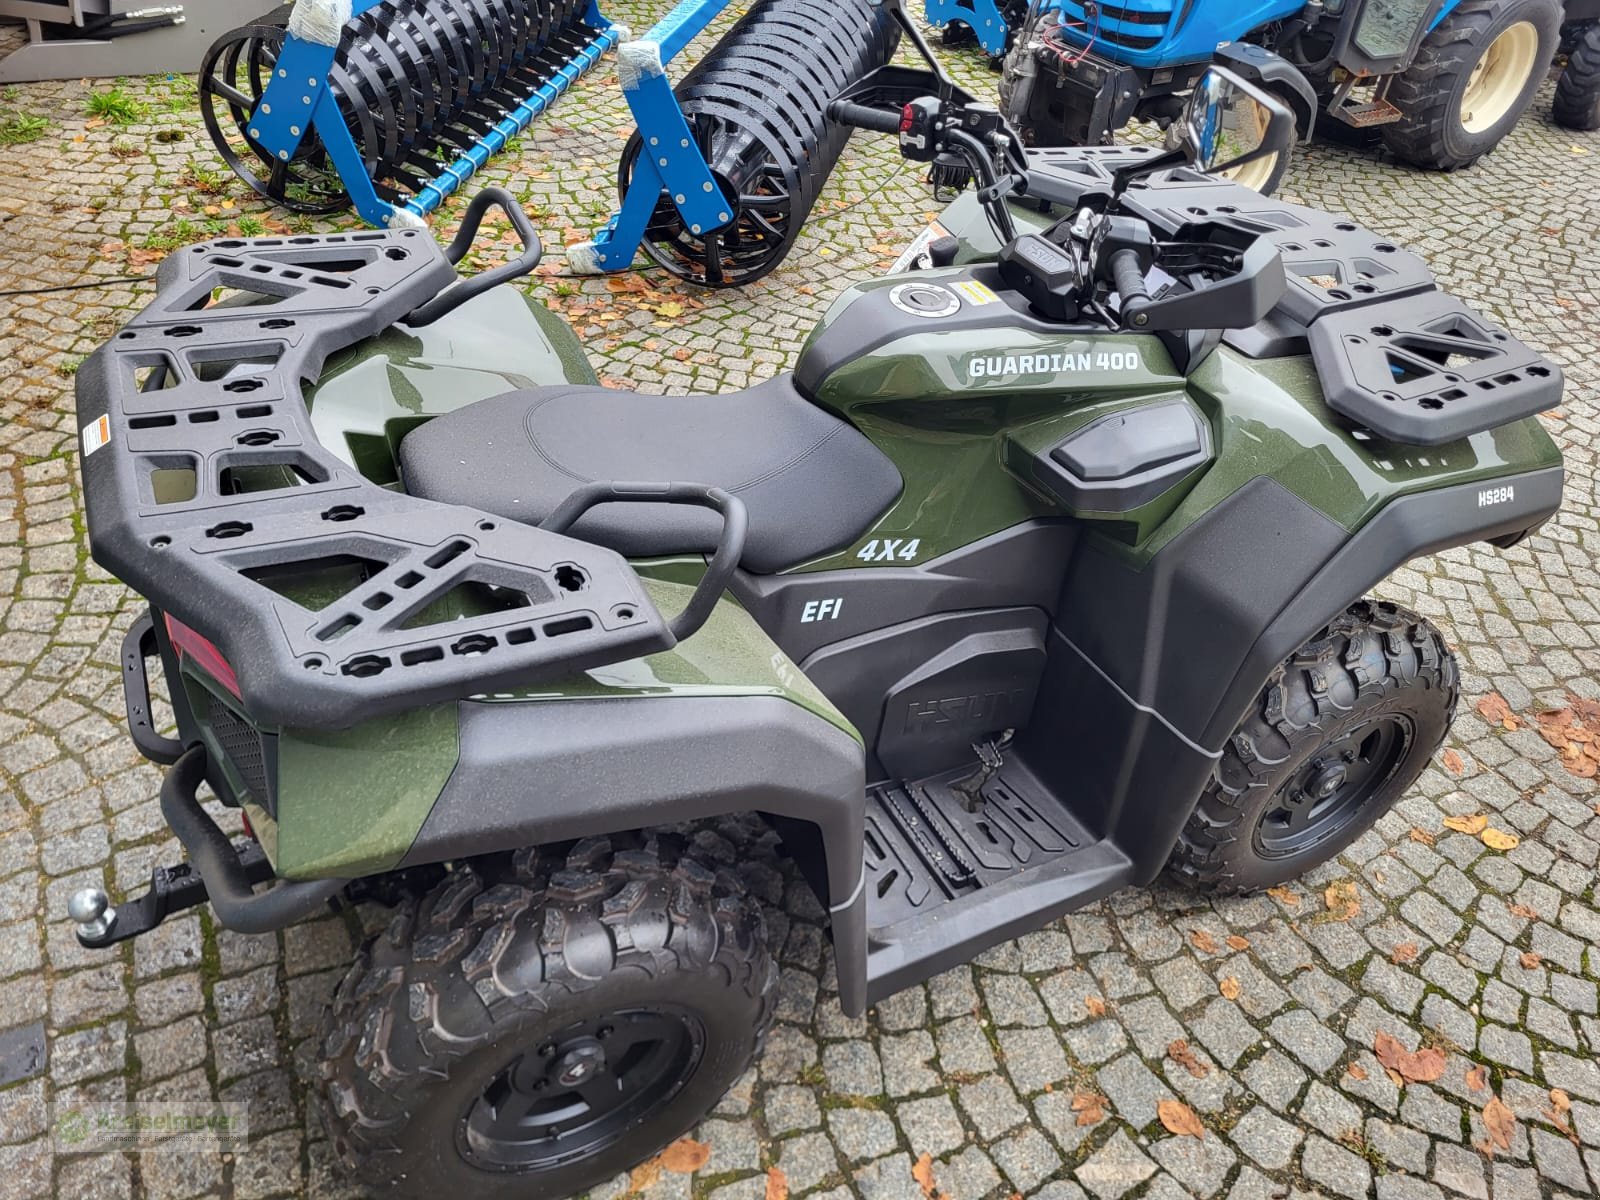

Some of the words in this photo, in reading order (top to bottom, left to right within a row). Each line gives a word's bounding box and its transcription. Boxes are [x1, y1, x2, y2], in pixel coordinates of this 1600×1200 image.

[969, 352, 1092, 377] GUARDIAN
[1096, 352, 1139, 371] 400
[1478, 485, 1515, 507] HS284
[856, 538, 921, 562] 4X4
[800, 597, 843, 623] EFI
